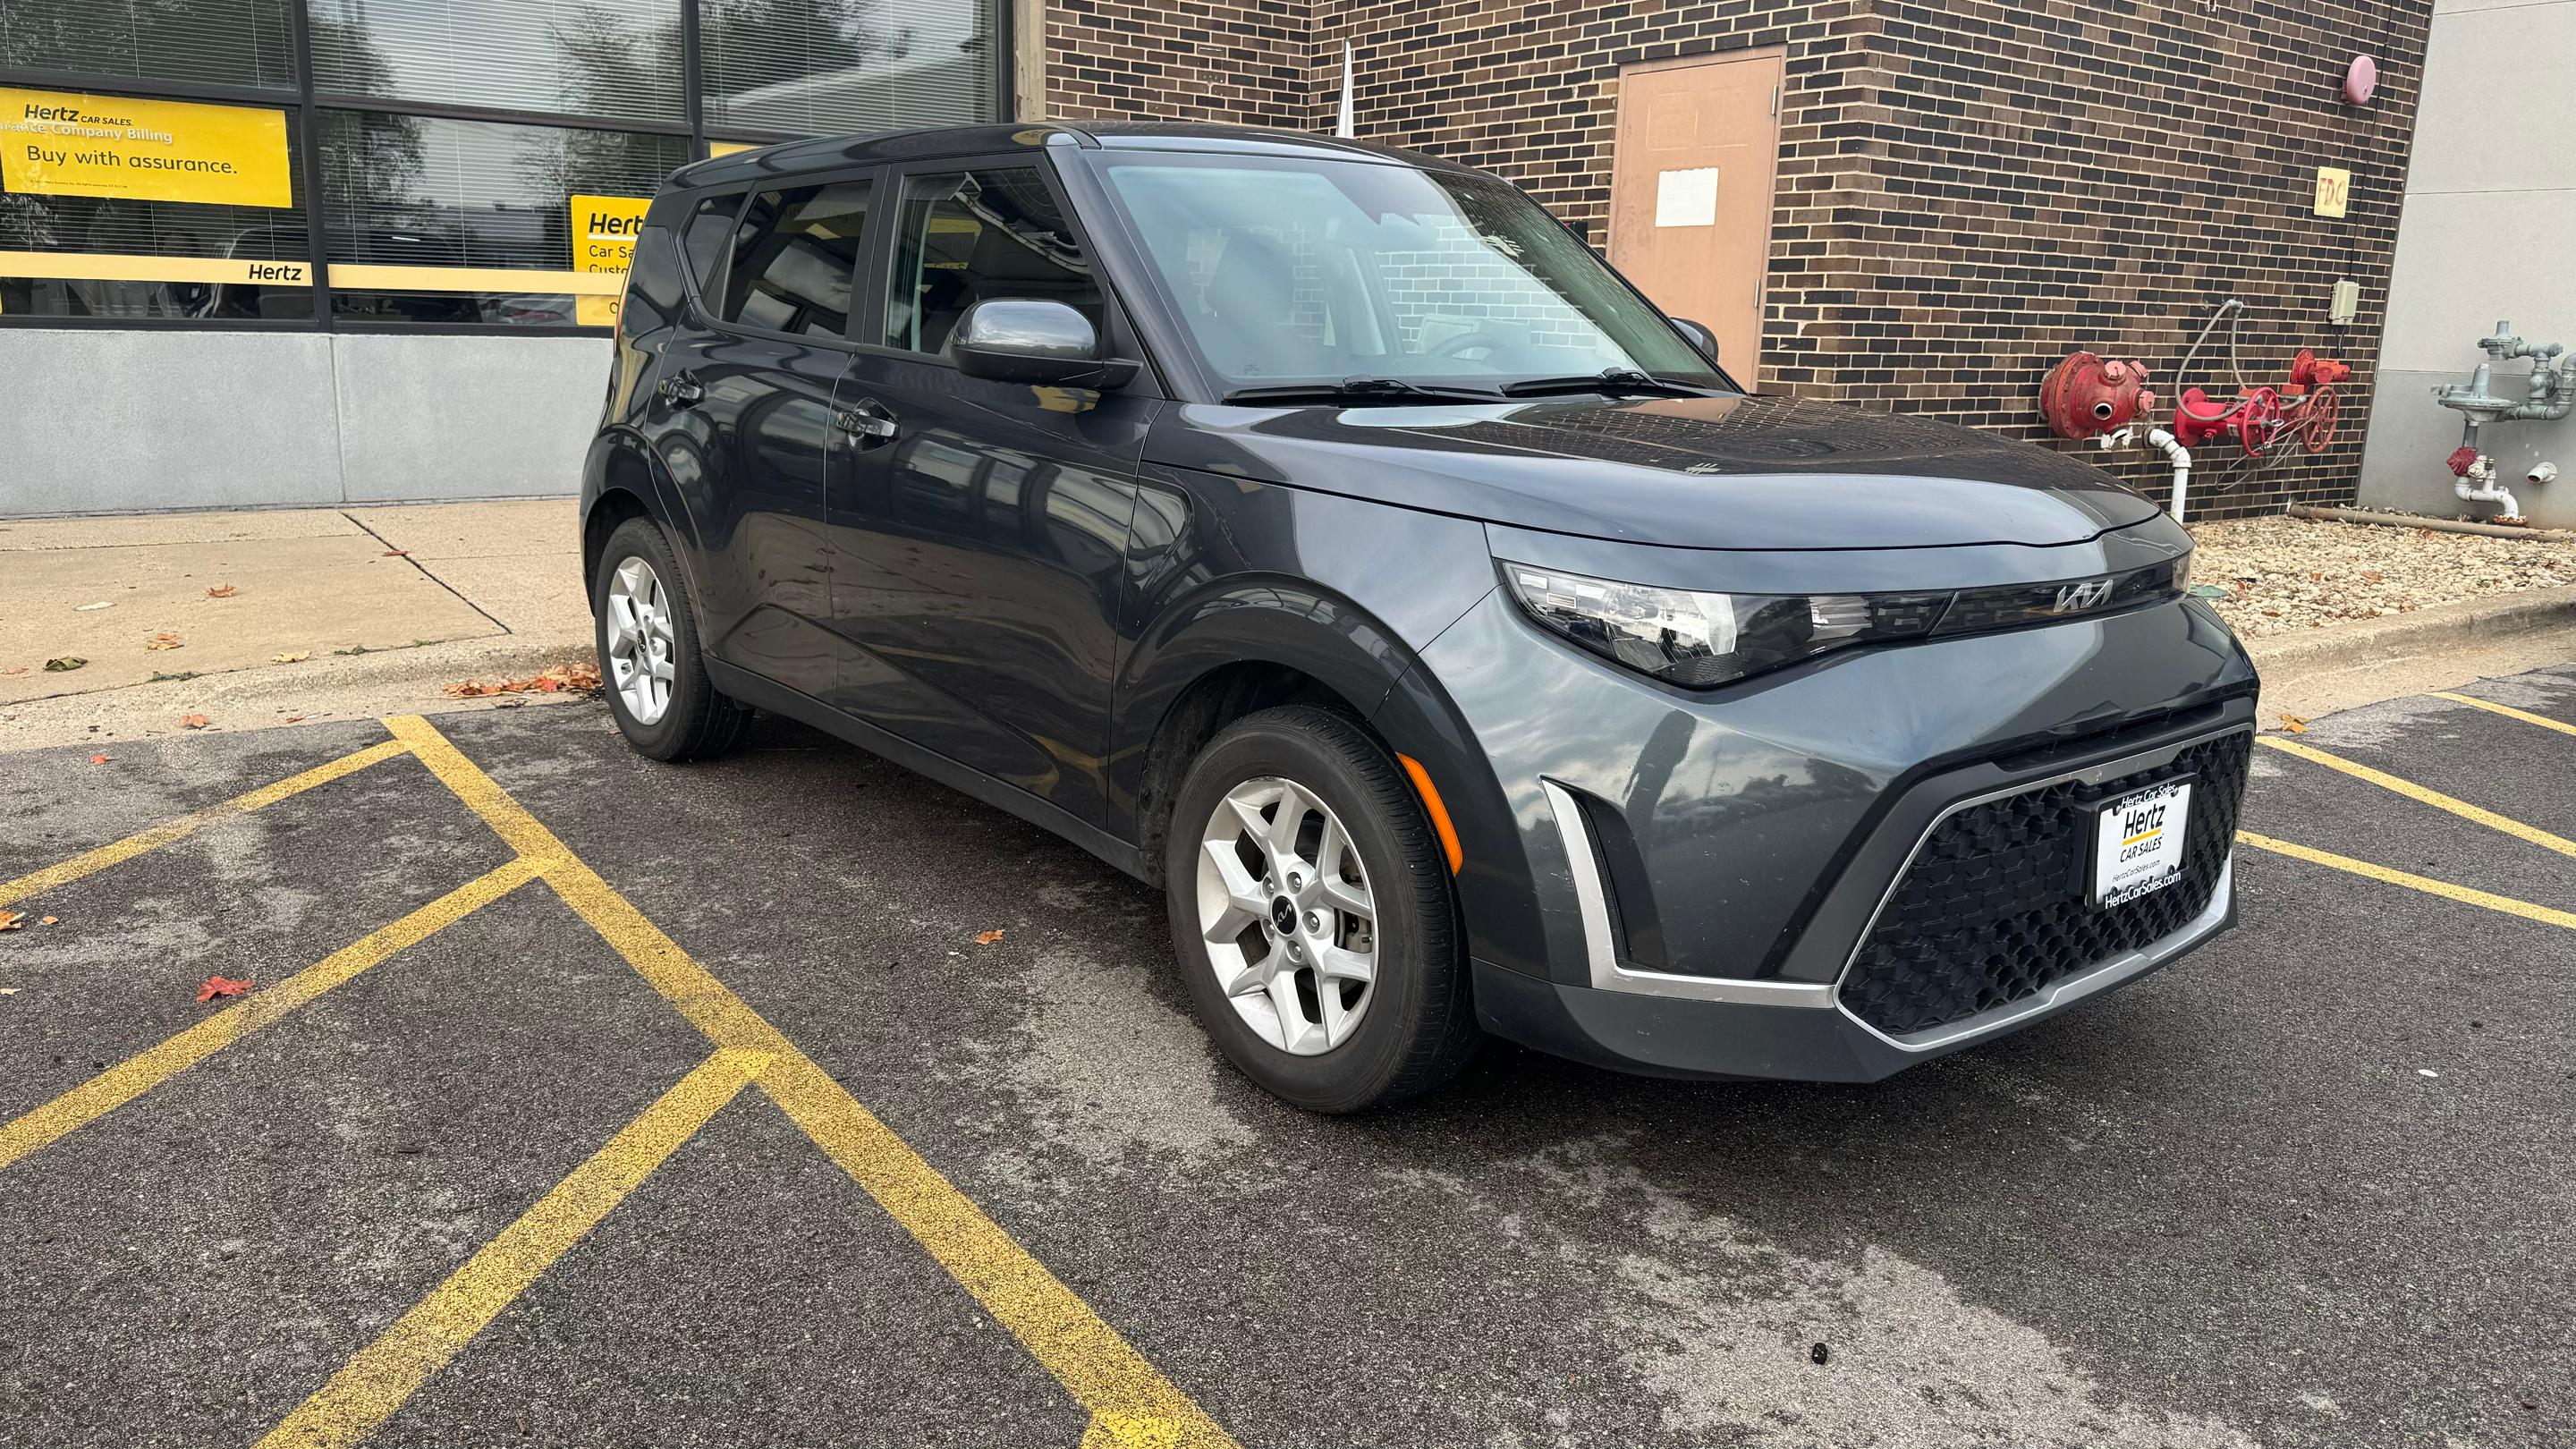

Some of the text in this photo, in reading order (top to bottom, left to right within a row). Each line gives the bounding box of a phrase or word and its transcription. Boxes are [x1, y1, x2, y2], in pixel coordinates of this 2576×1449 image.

[24, 104, 80, 123] Hertz
[80, 115, 100, 124] CAR
[52, 125, 122, 141] Company
[127, 128, 173, 144] Billing
[27, 145, 237, 174] Buy with assurance.
[589, 244, 614, 258] Car
[249, 263, 302, 281] Hertz
[2121, 782, 2176, 809] Hertz Car Sales
[2123, 803, 2166, 839] Hertz
[2120, 836, 2163, 863] CAR SALES
[2112, 860, 2160, 883] HertzCarSales.com
[2105, 871, 2182, 910] HertzCarSales.com
